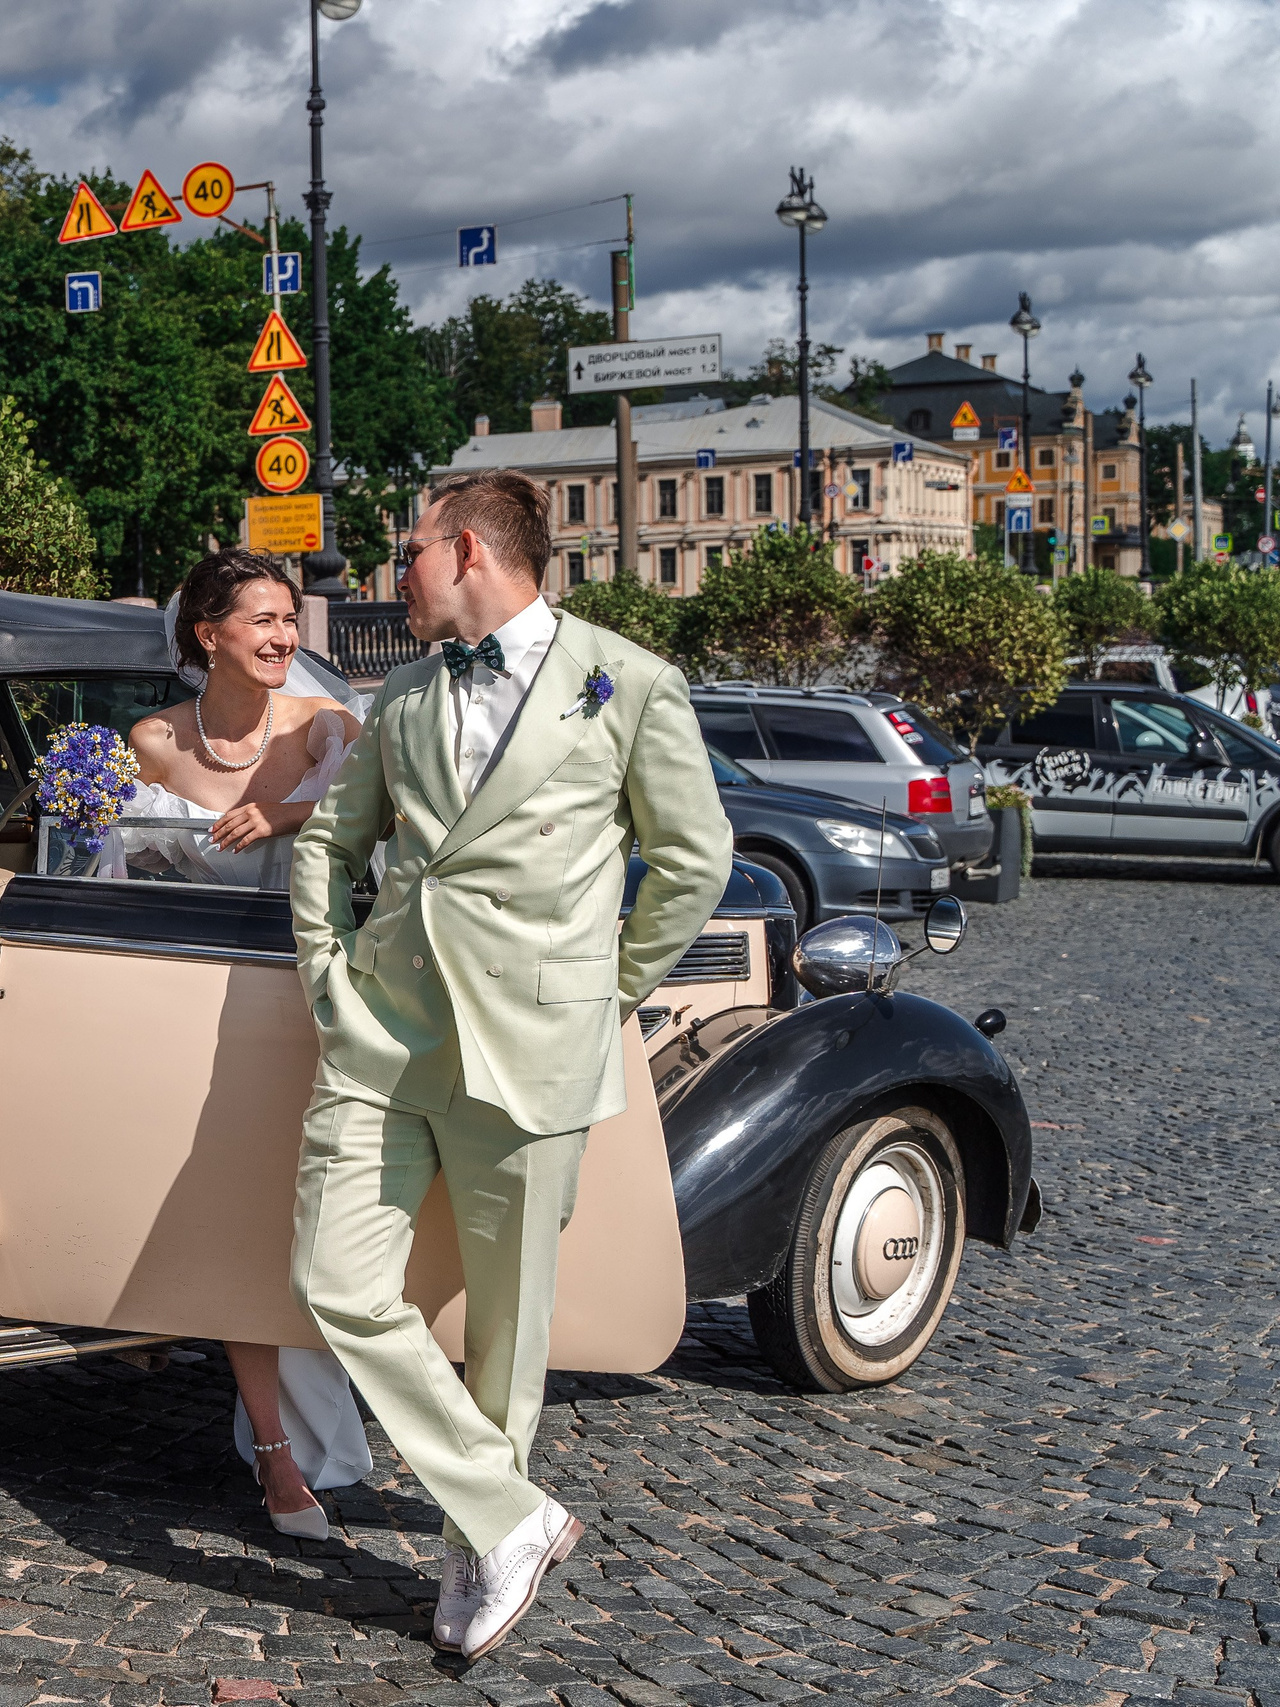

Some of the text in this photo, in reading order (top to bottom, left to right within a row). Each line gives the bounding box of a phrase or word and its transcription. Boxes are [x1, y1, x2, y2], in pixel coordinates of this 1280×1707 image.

[194, 179, 223, 201] 40
[587, 345, 666, 366] ДВОРЦОВЫЙ
[668, 346, 697, 357] мост
[593, 365, 661, 384] БИРЖЕВОЙ
[663, 366, 693, 377] мост
[269, 454, 297, 475] 40
